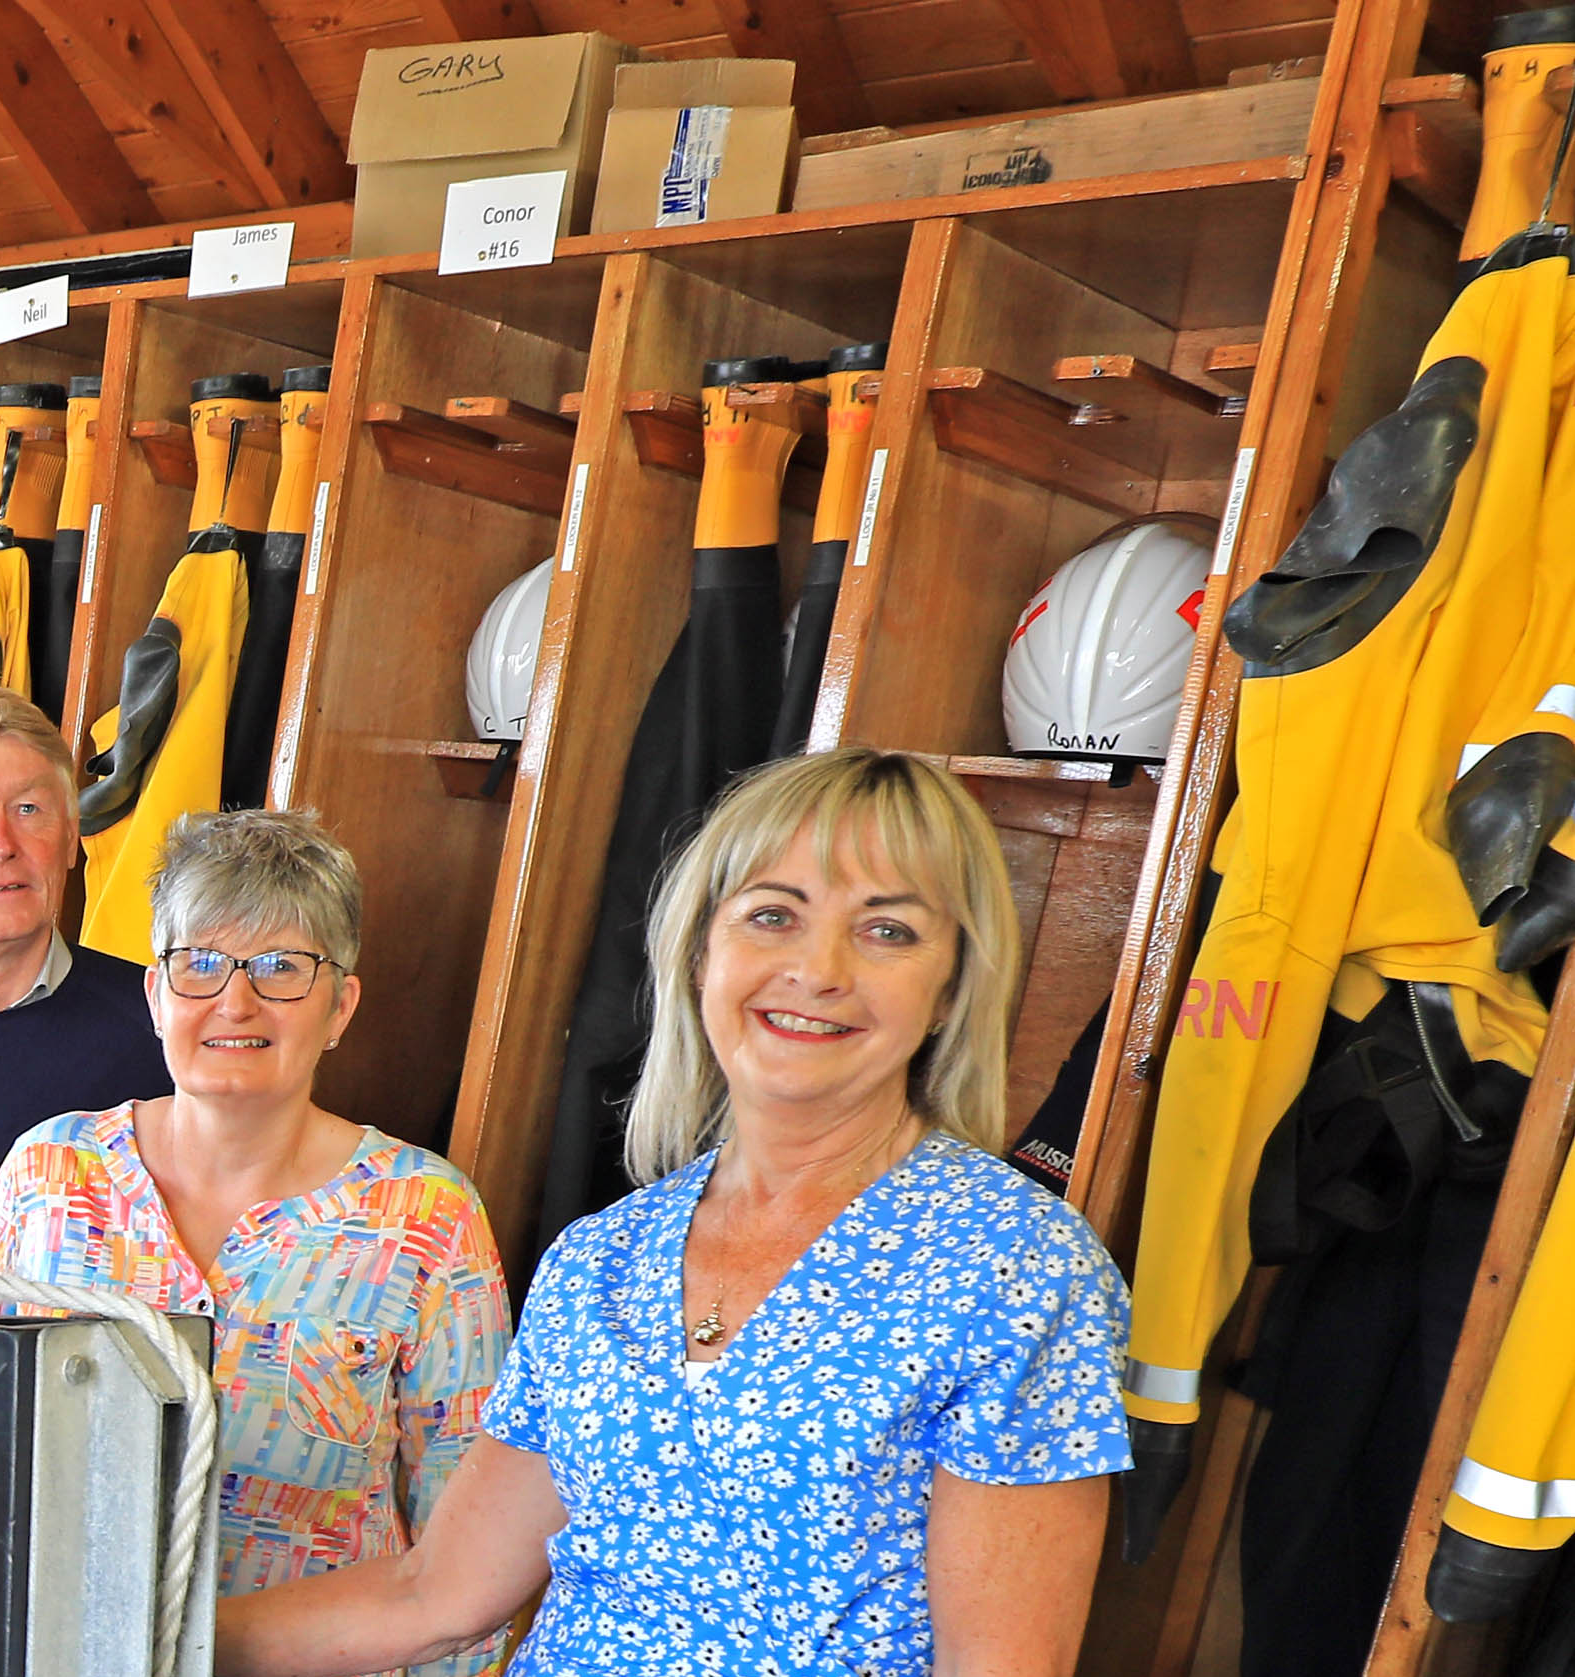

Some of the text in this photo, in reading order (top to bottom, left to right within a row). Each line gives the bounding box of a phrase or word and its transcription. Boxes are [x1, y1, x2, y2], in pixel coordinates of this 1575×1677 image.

[483, 206, 536, 224] Conor
[232, 227, 278, 246] James
[488, 240, 520, 260] #16
[23, 303, 47, 325] Neil
[872, 477, 880, 486] 11
[1223, 506, 1238, 546] LOCKER
[1236, 478, 1245, 488] 10
